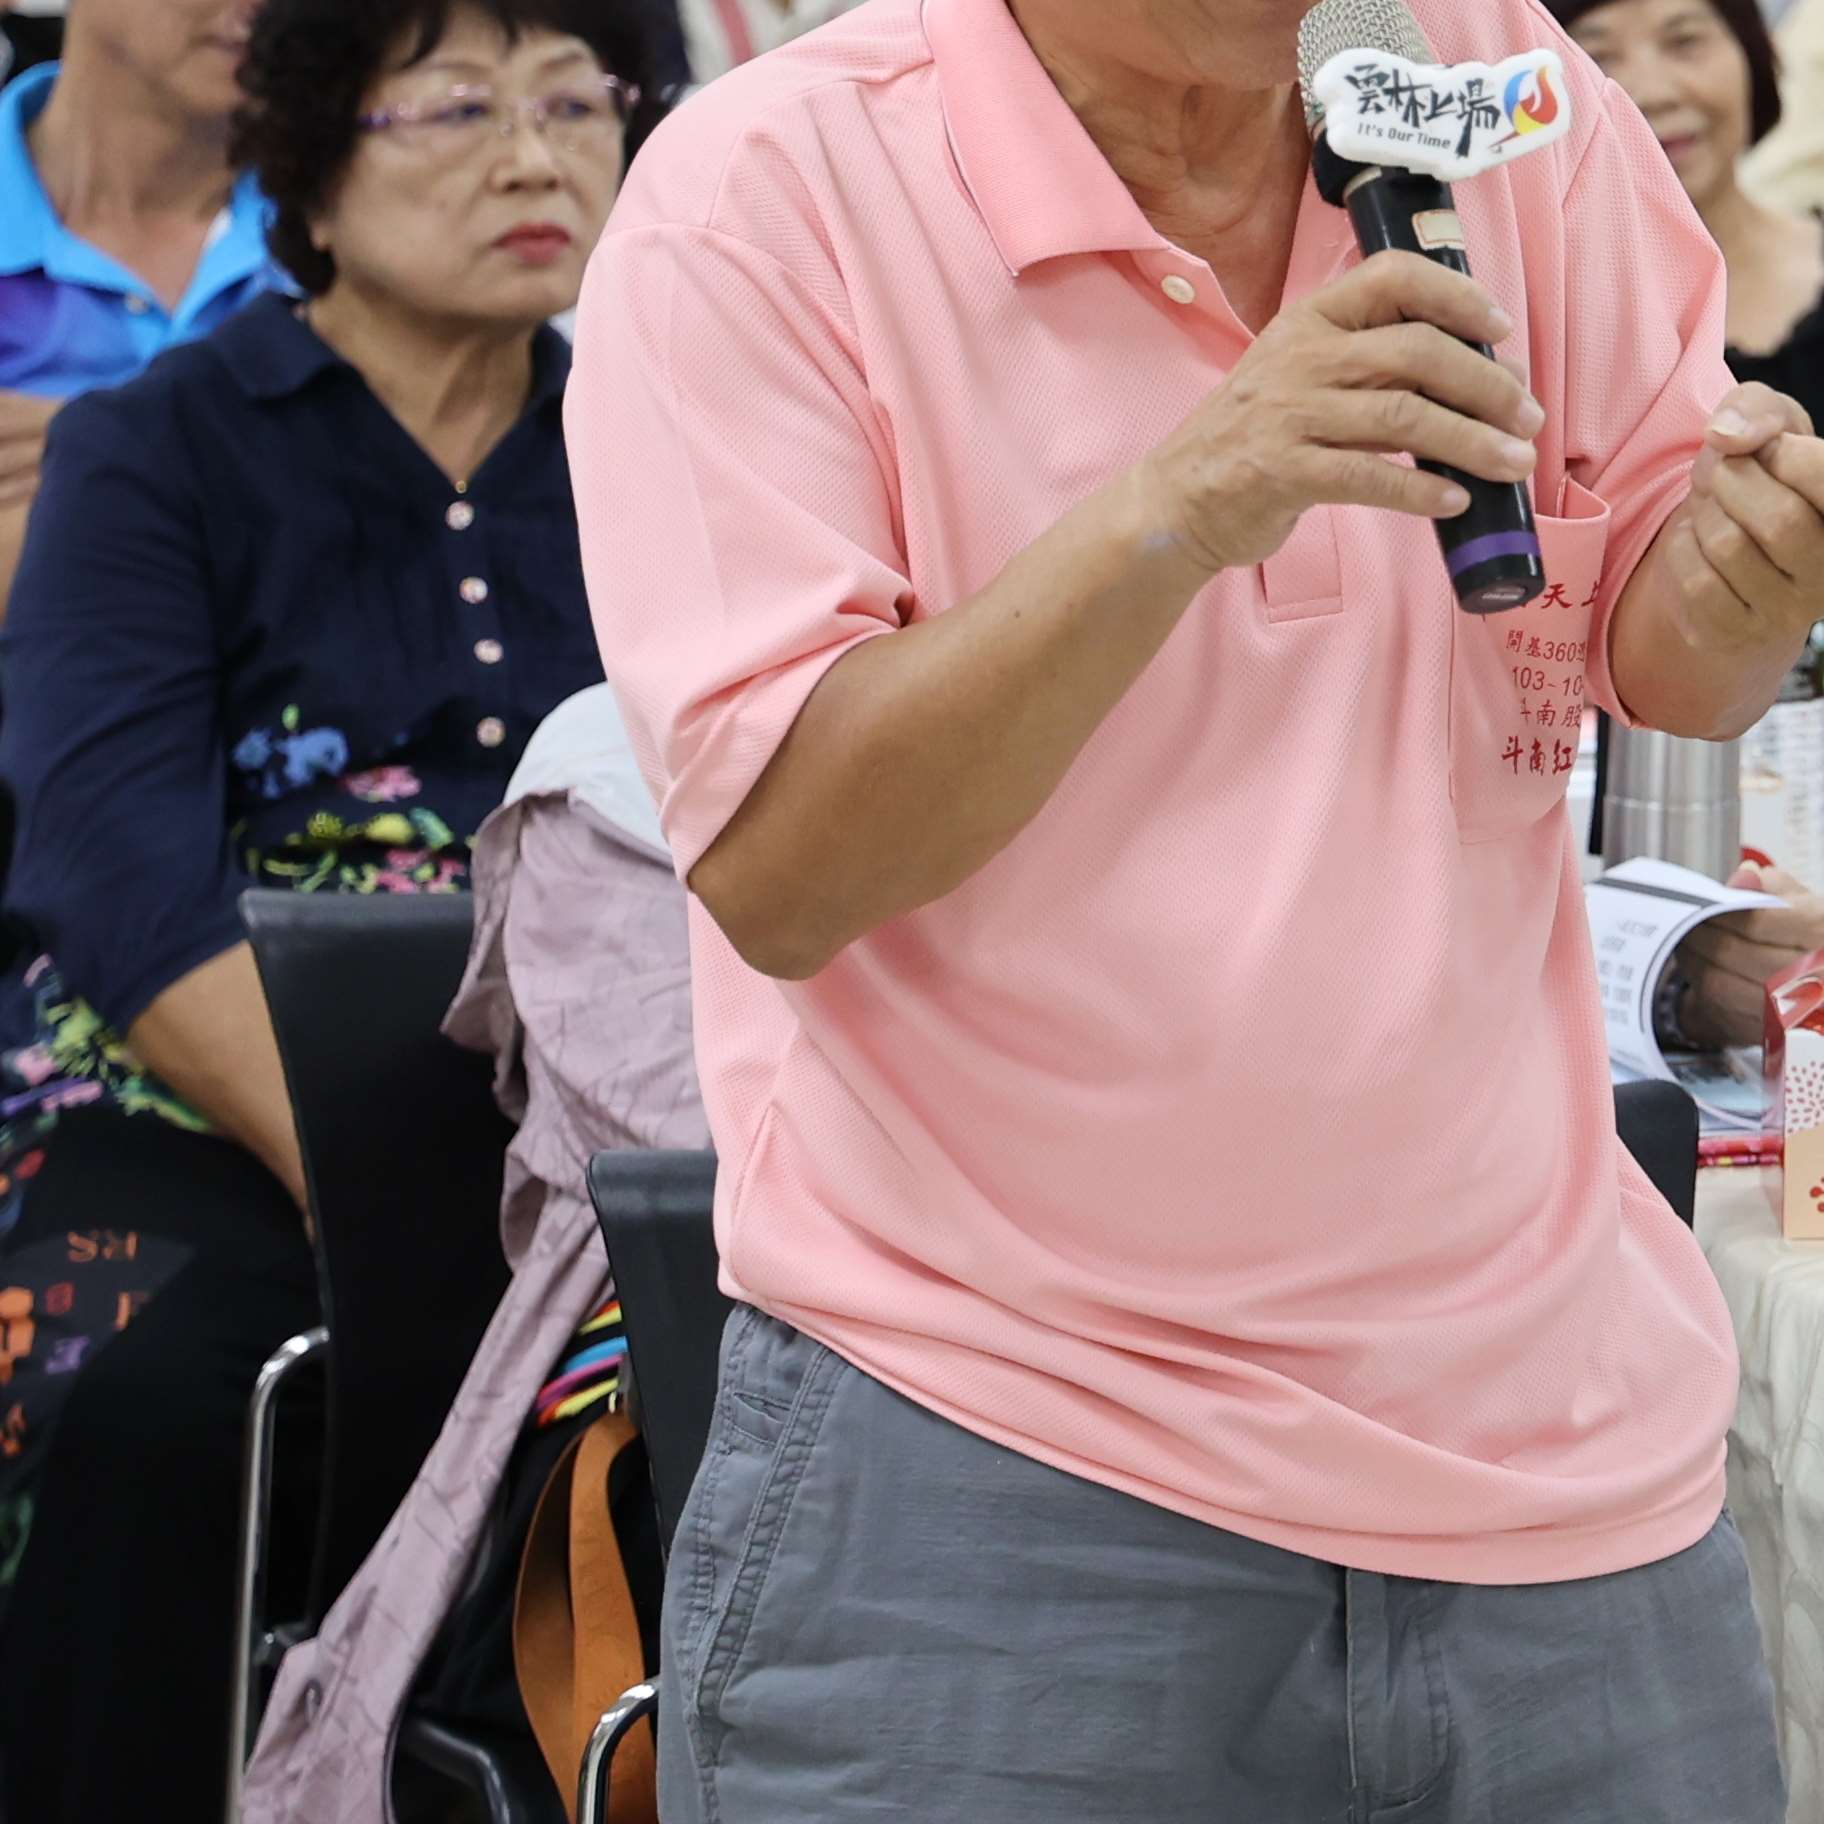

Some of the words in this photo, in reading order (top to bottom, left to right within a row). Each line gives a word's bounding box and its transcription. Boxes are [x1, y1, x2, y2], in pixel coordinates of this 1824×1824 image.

[1345, 64, 1501, 158] 雲林上場
[1358, 122, 1384, 138] It's
[1388, 127, 1413, 143] Our
[1417, 132, 1451, 149] Time
